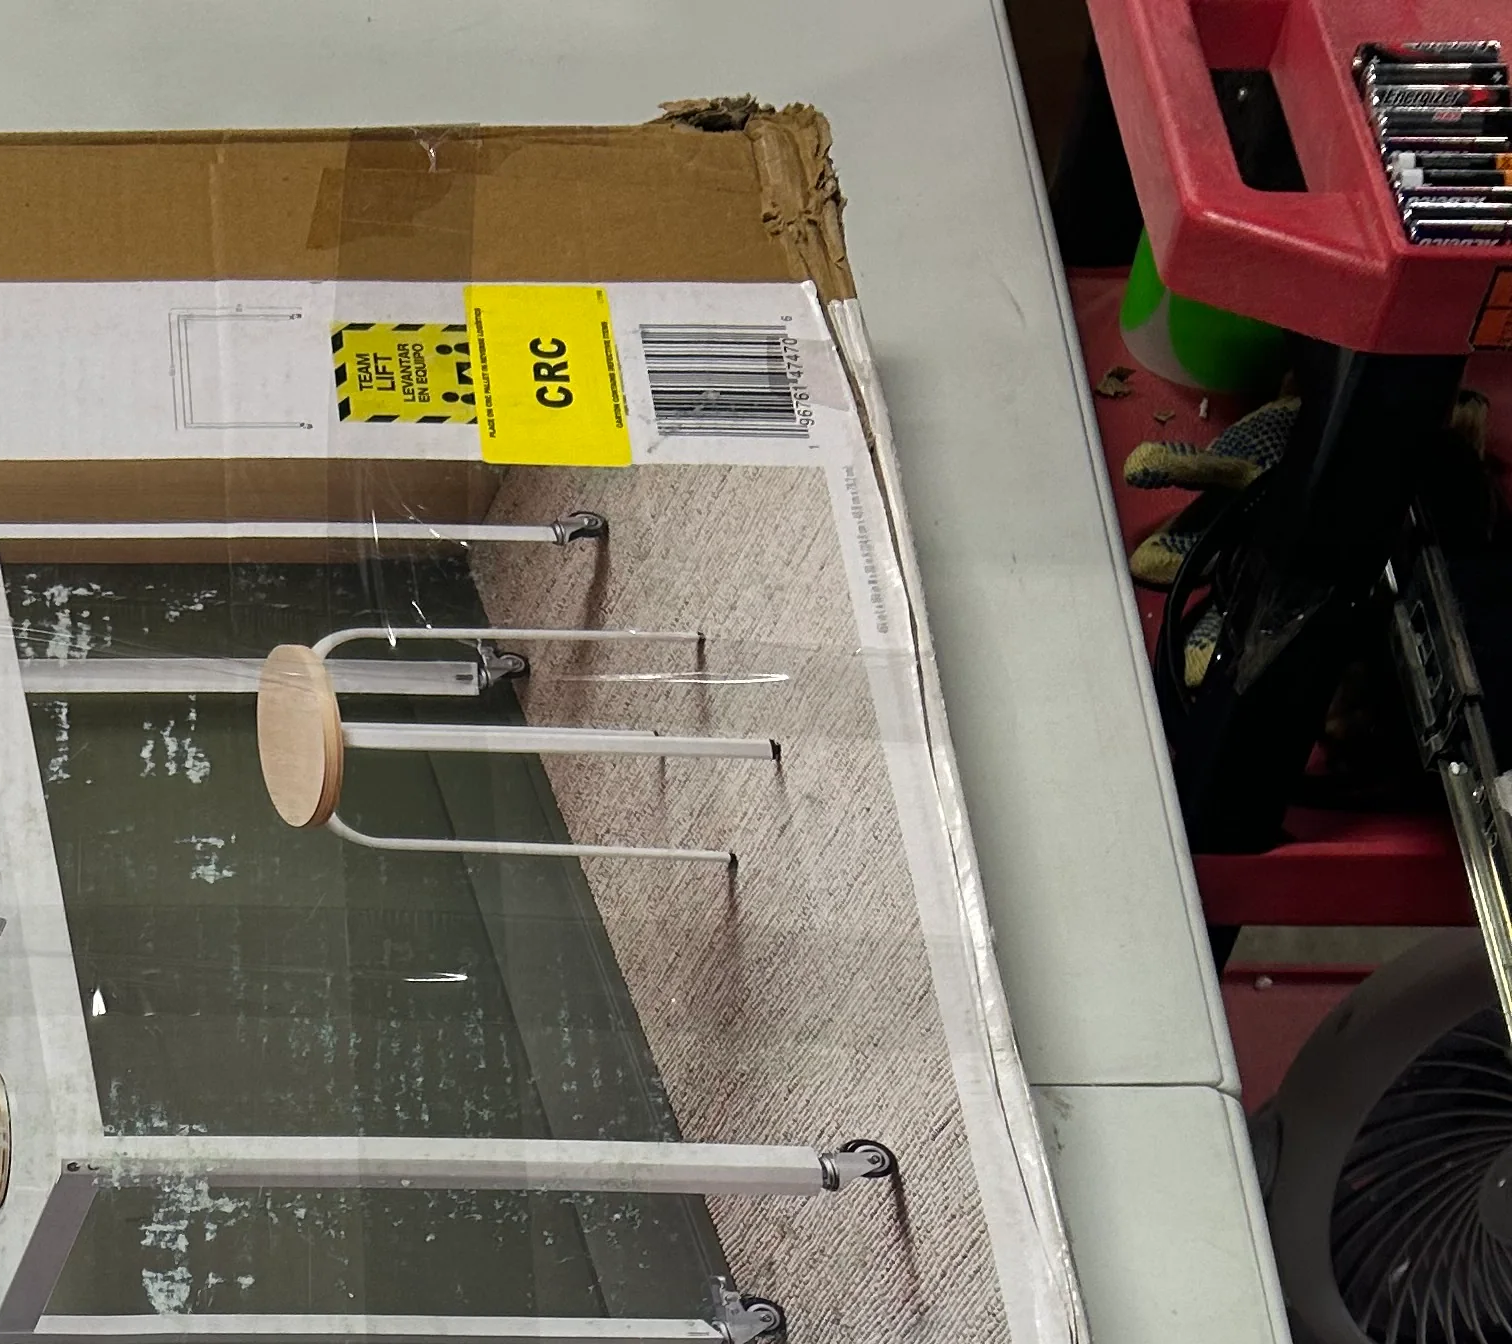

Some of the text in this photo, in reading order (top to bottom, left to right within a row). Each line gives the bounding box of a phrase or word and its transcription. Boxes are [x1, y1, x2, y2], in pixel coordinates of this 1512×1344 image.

[1383, 90, 1464, 107] Energizer
[356, 353, 373, 391] TEAM
[373, 352, 396, 391] LIFT
[397, 343, 416, 402] LEVANTAR
[412, 343, 430, 402] EN EQUIPO
[529, 337, 574, 409] CRC
[782, 337, 804, 378] 47470
[791, 385, 815, 427] 96761
